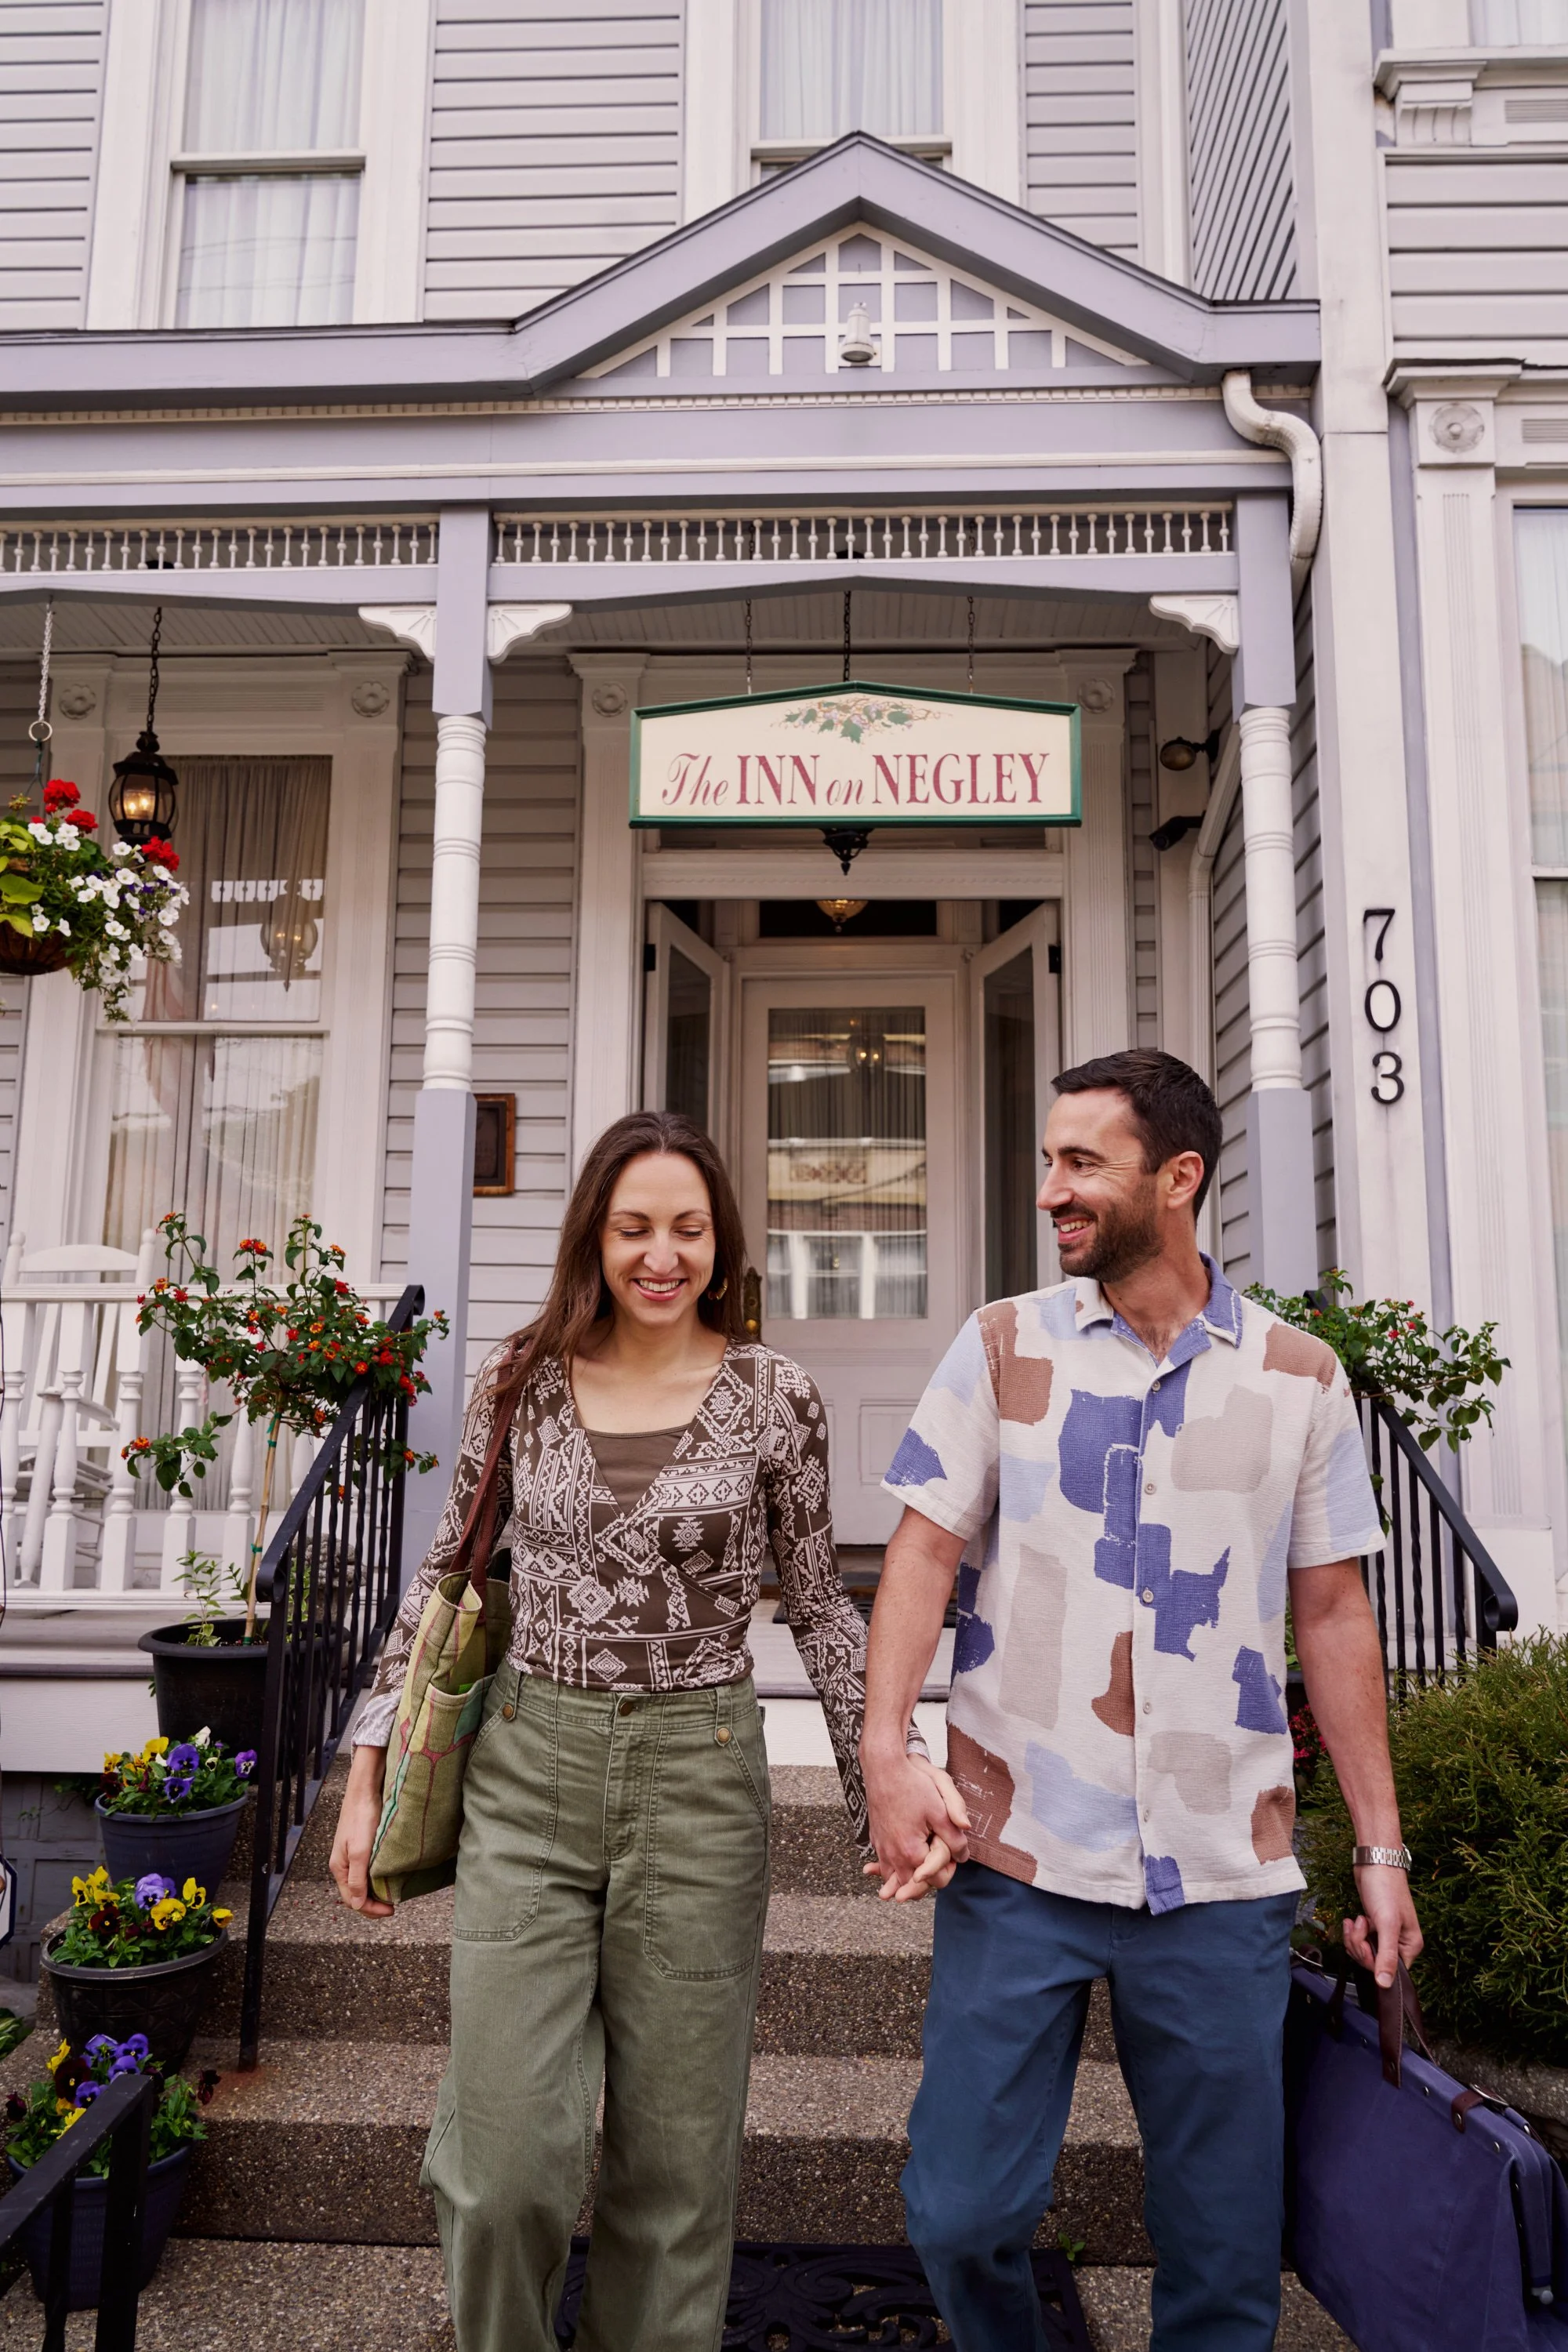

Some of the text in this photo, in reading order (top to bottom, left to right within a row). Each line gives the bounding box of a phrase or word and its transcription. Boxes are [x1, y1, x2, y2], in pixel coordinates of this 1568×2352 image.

[662, 753, 1050, 805] The INN on NEGLEY
[1363, 908, 1405, 1107] 703
